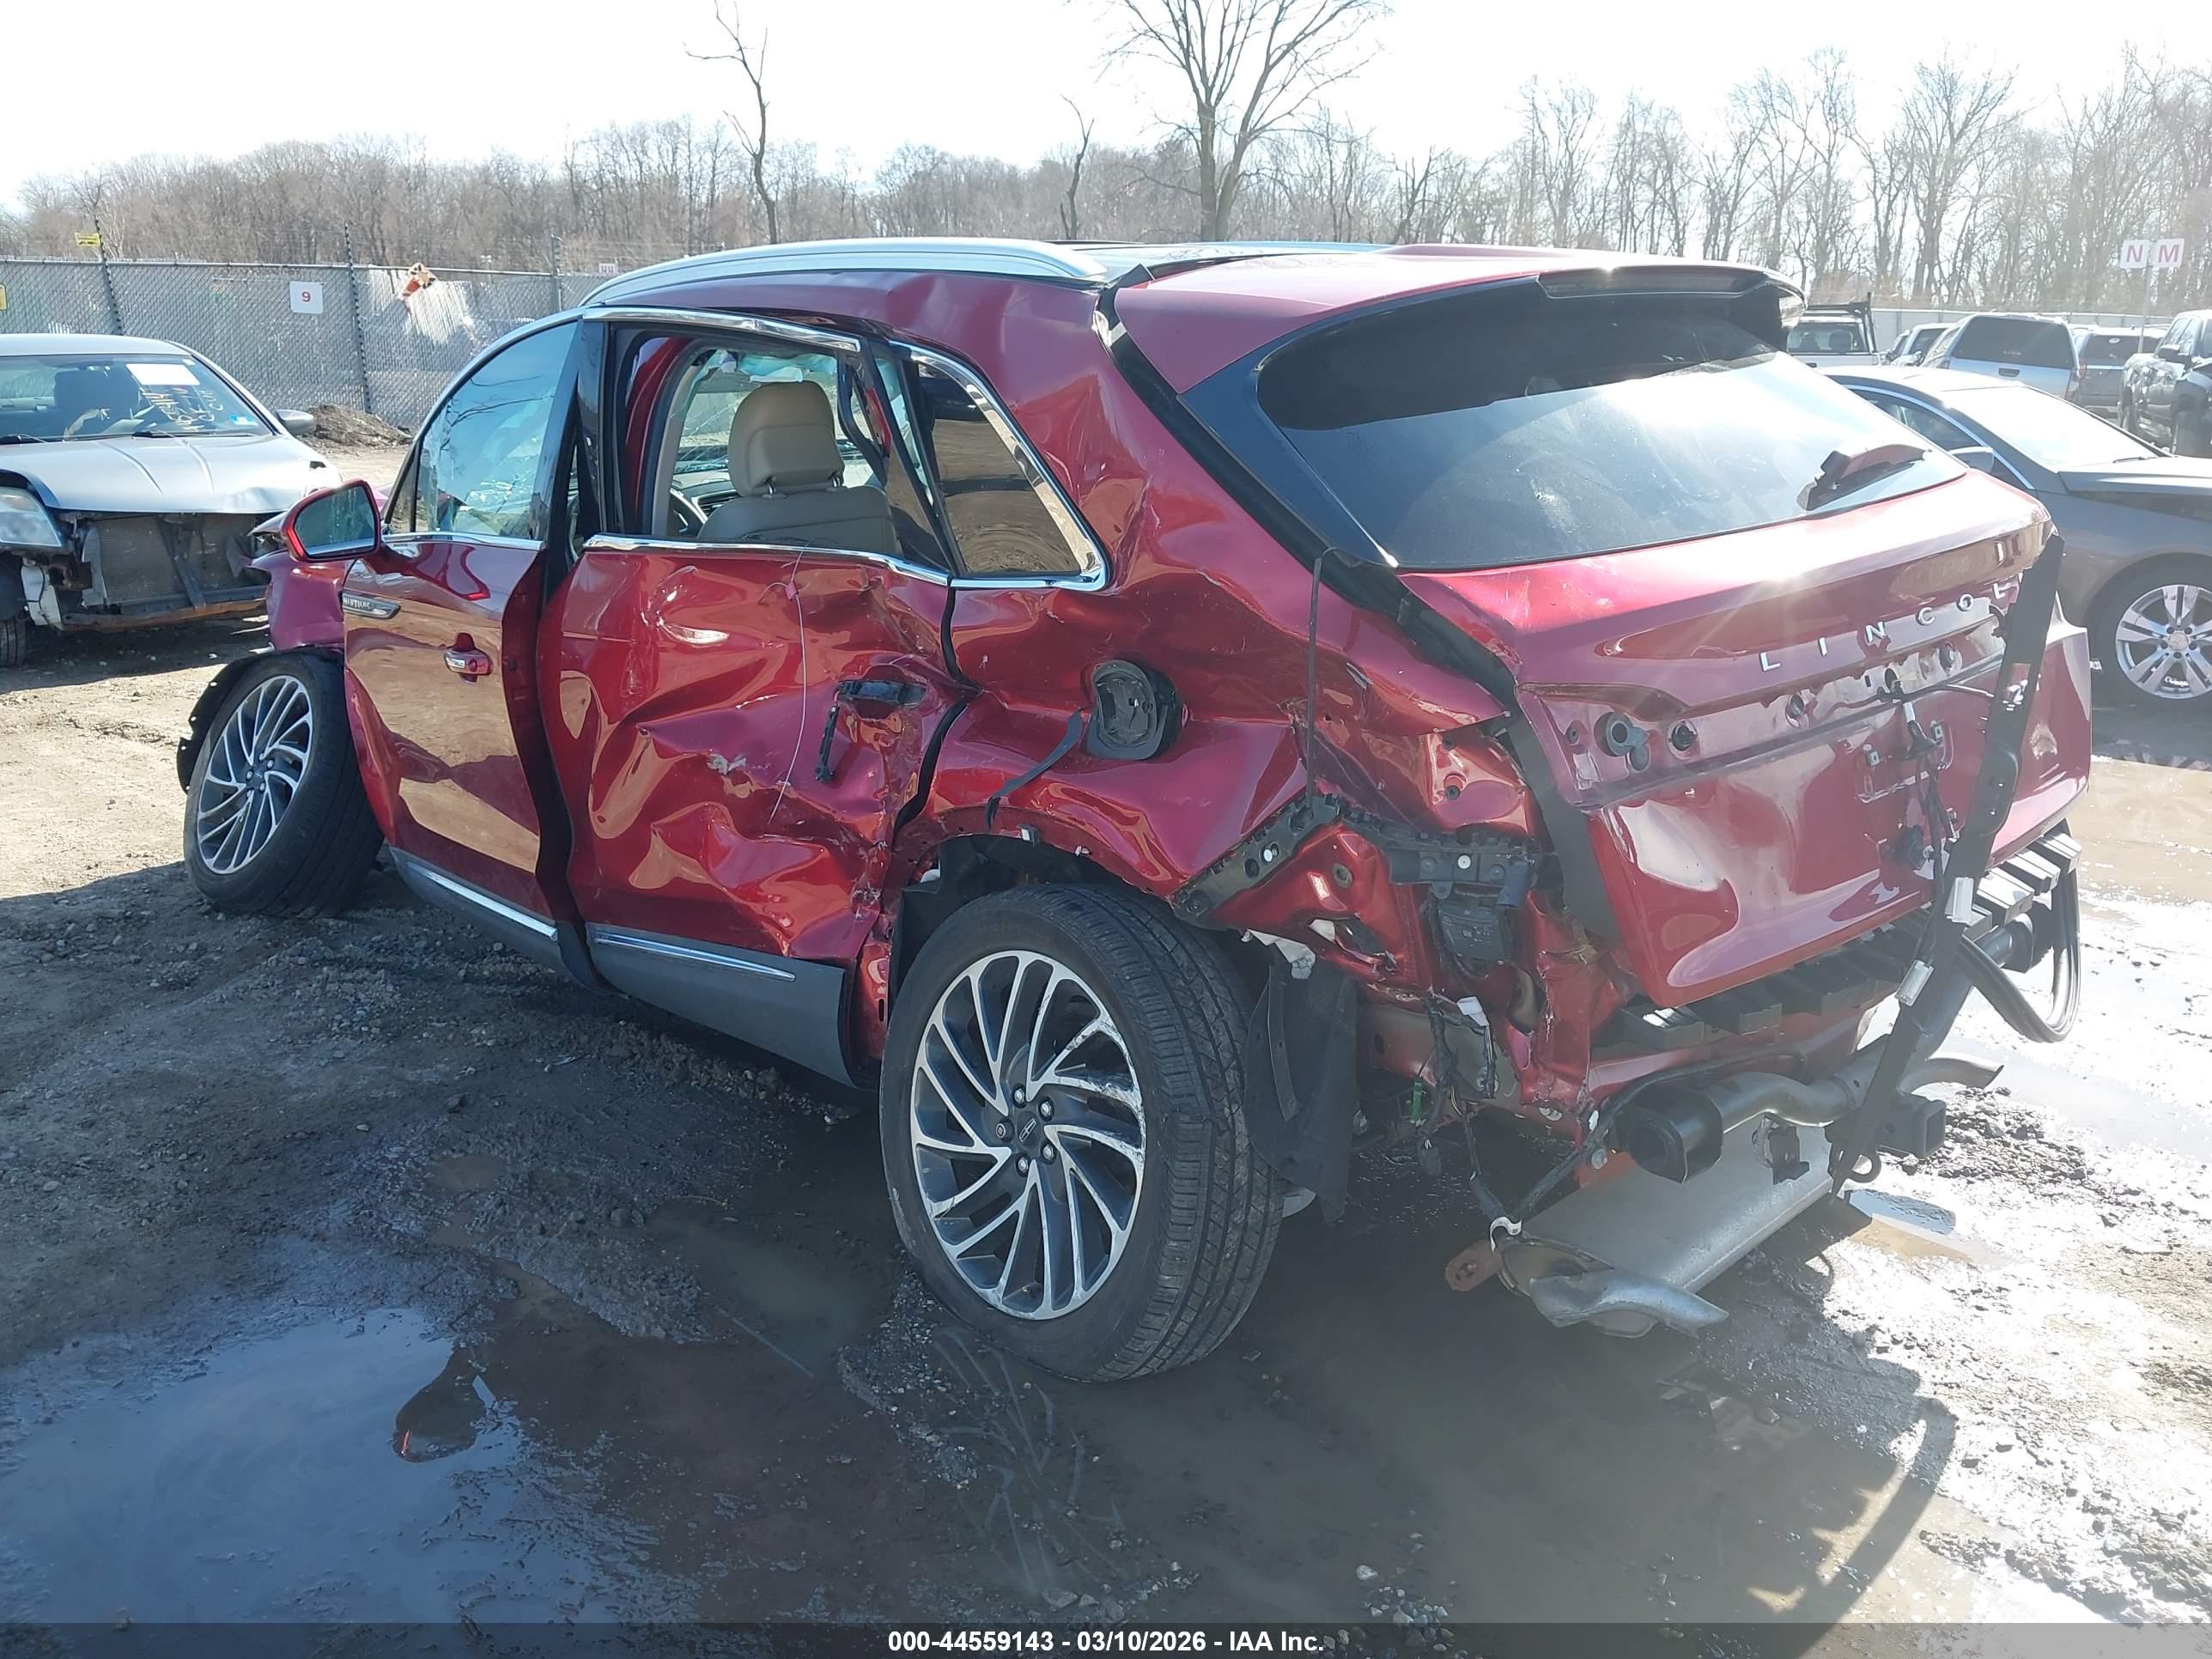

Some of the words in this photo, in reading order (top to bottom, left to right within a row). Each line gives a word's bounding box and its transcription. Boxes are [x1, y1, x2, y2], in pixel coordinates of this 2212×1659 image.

[2126, 244, 2143, 263] N
[2158, 244, 2179, 263] M
[301, 291, 311, 302] 9
[1759, 572, 2023, 672] LINCOL
